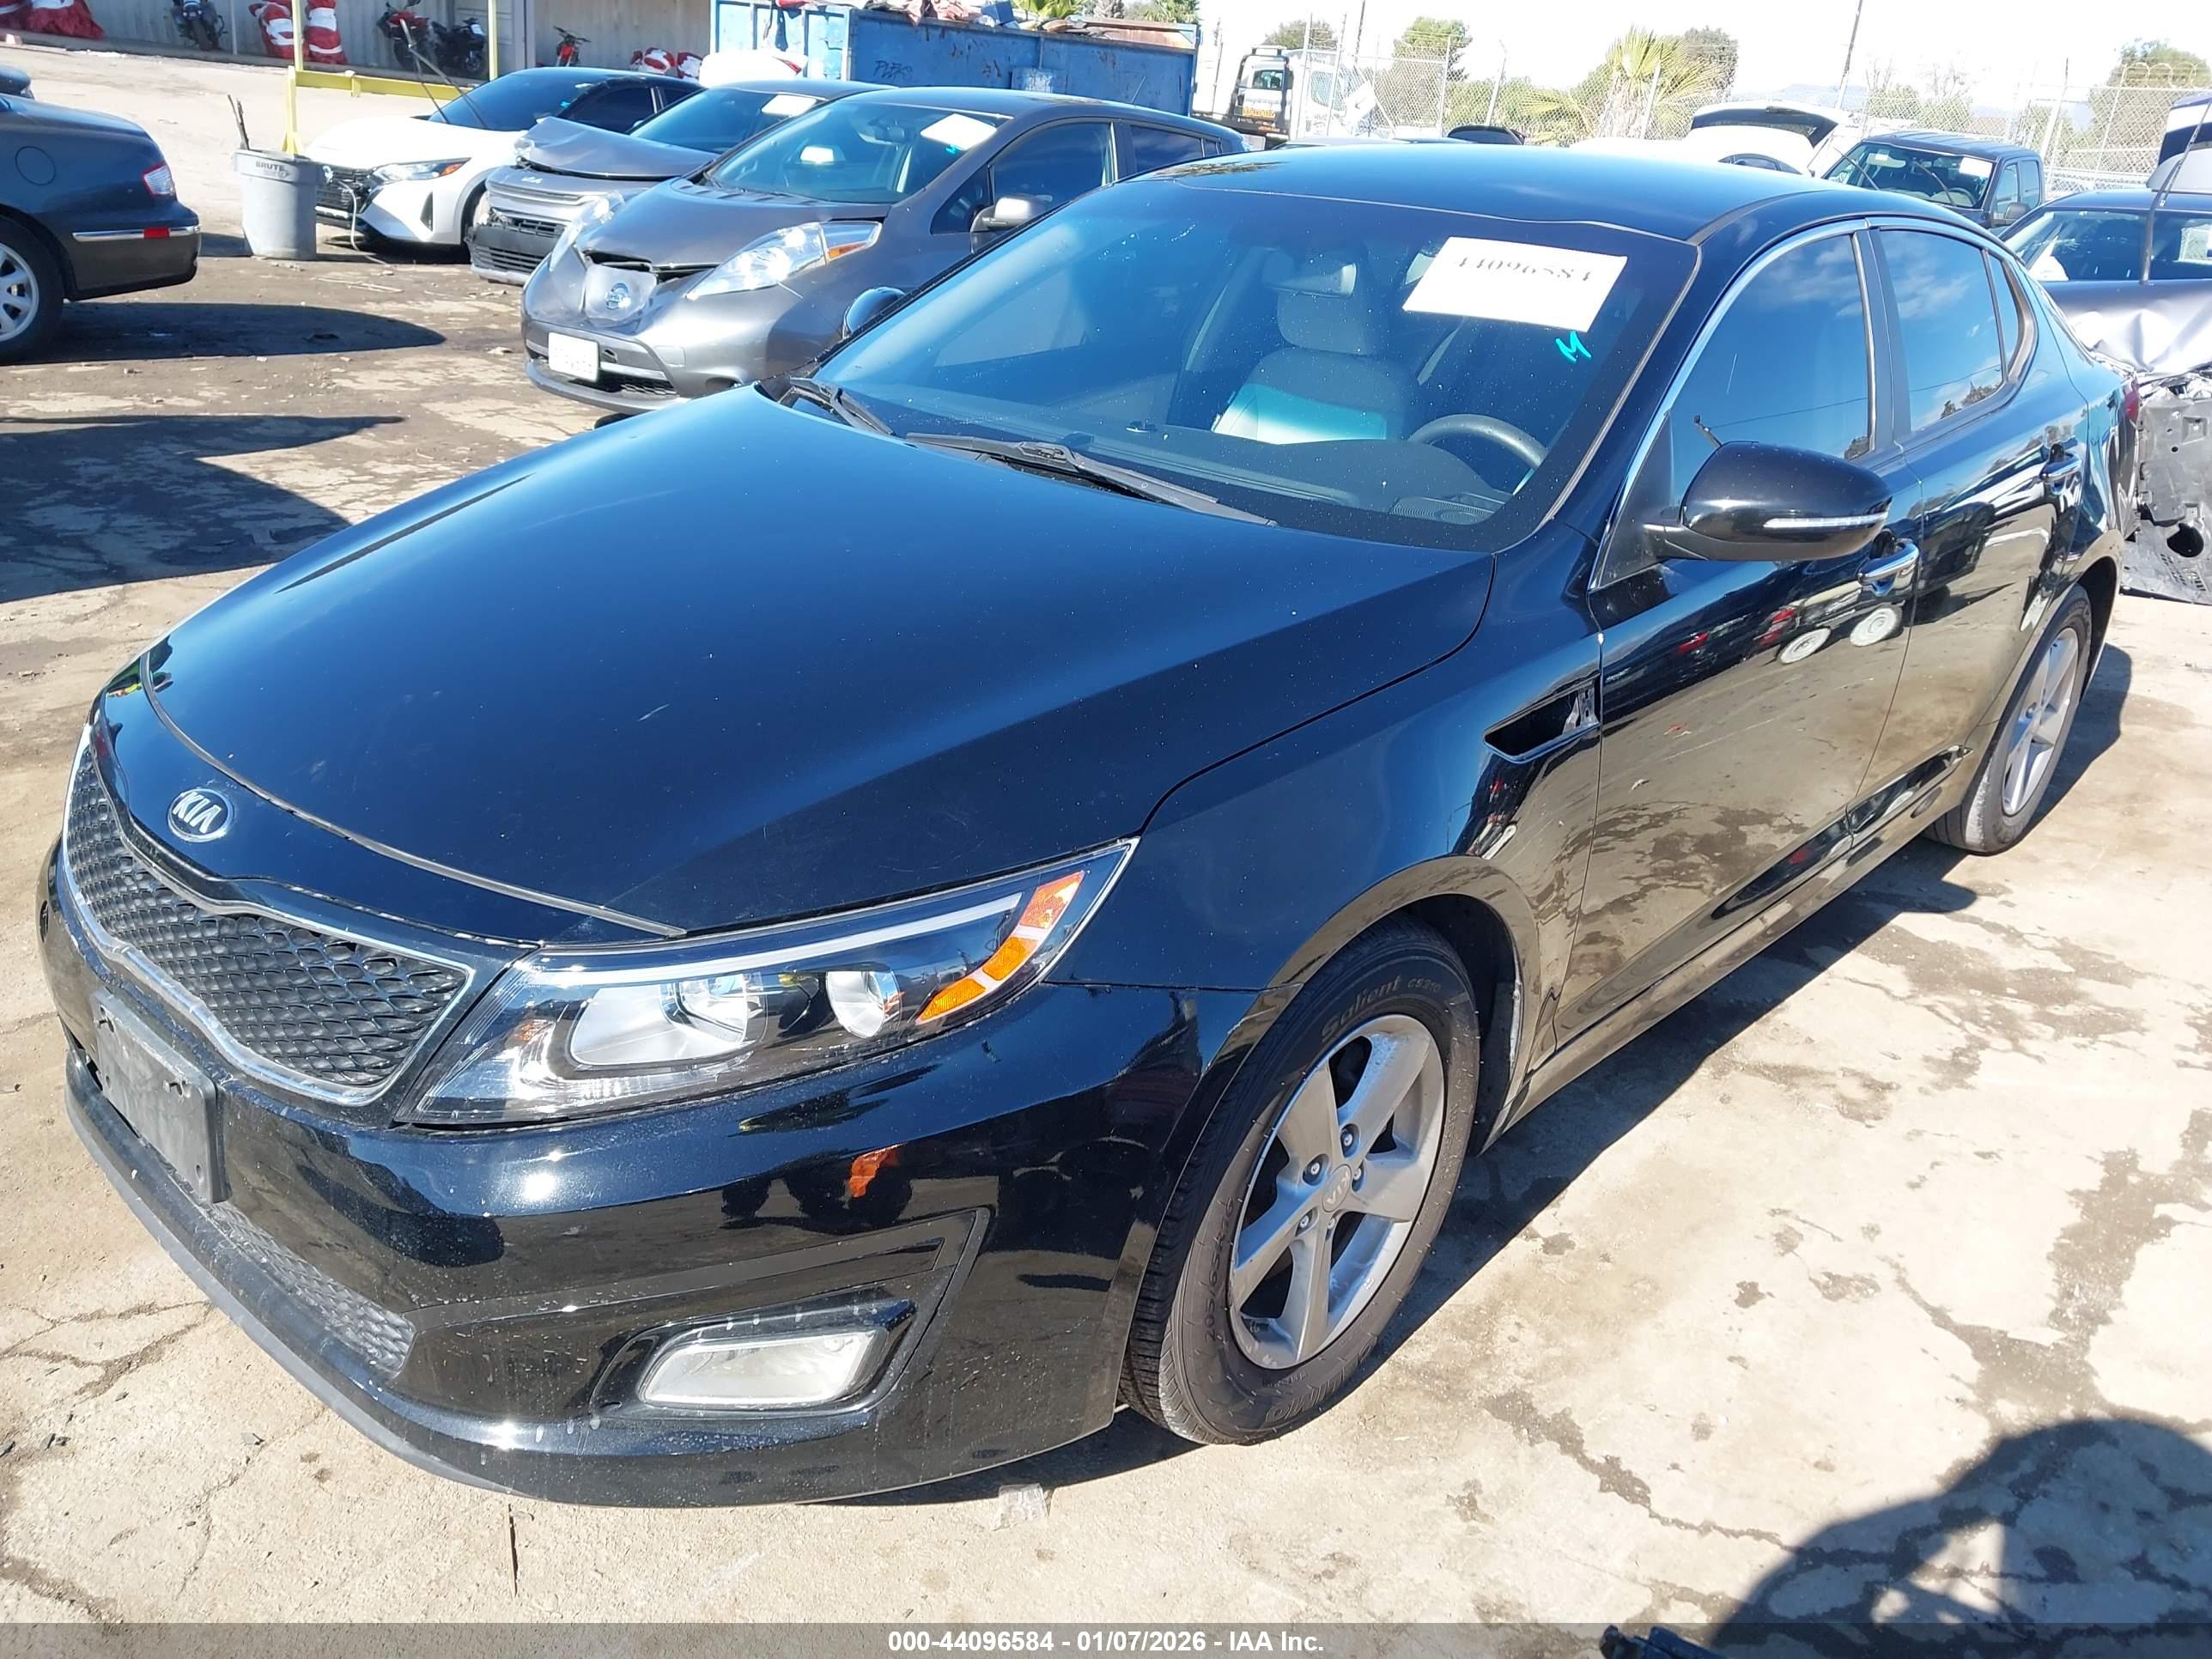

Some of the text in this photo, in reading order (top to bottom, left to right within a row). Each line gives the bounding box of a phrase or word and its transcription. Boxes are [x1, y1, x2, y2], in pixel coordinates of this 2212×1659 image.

[256, 161, 287, 172] BRUTE
[173, 791, 222, 834] KIA
[1326, 1170, 1351, 1205] KIA
